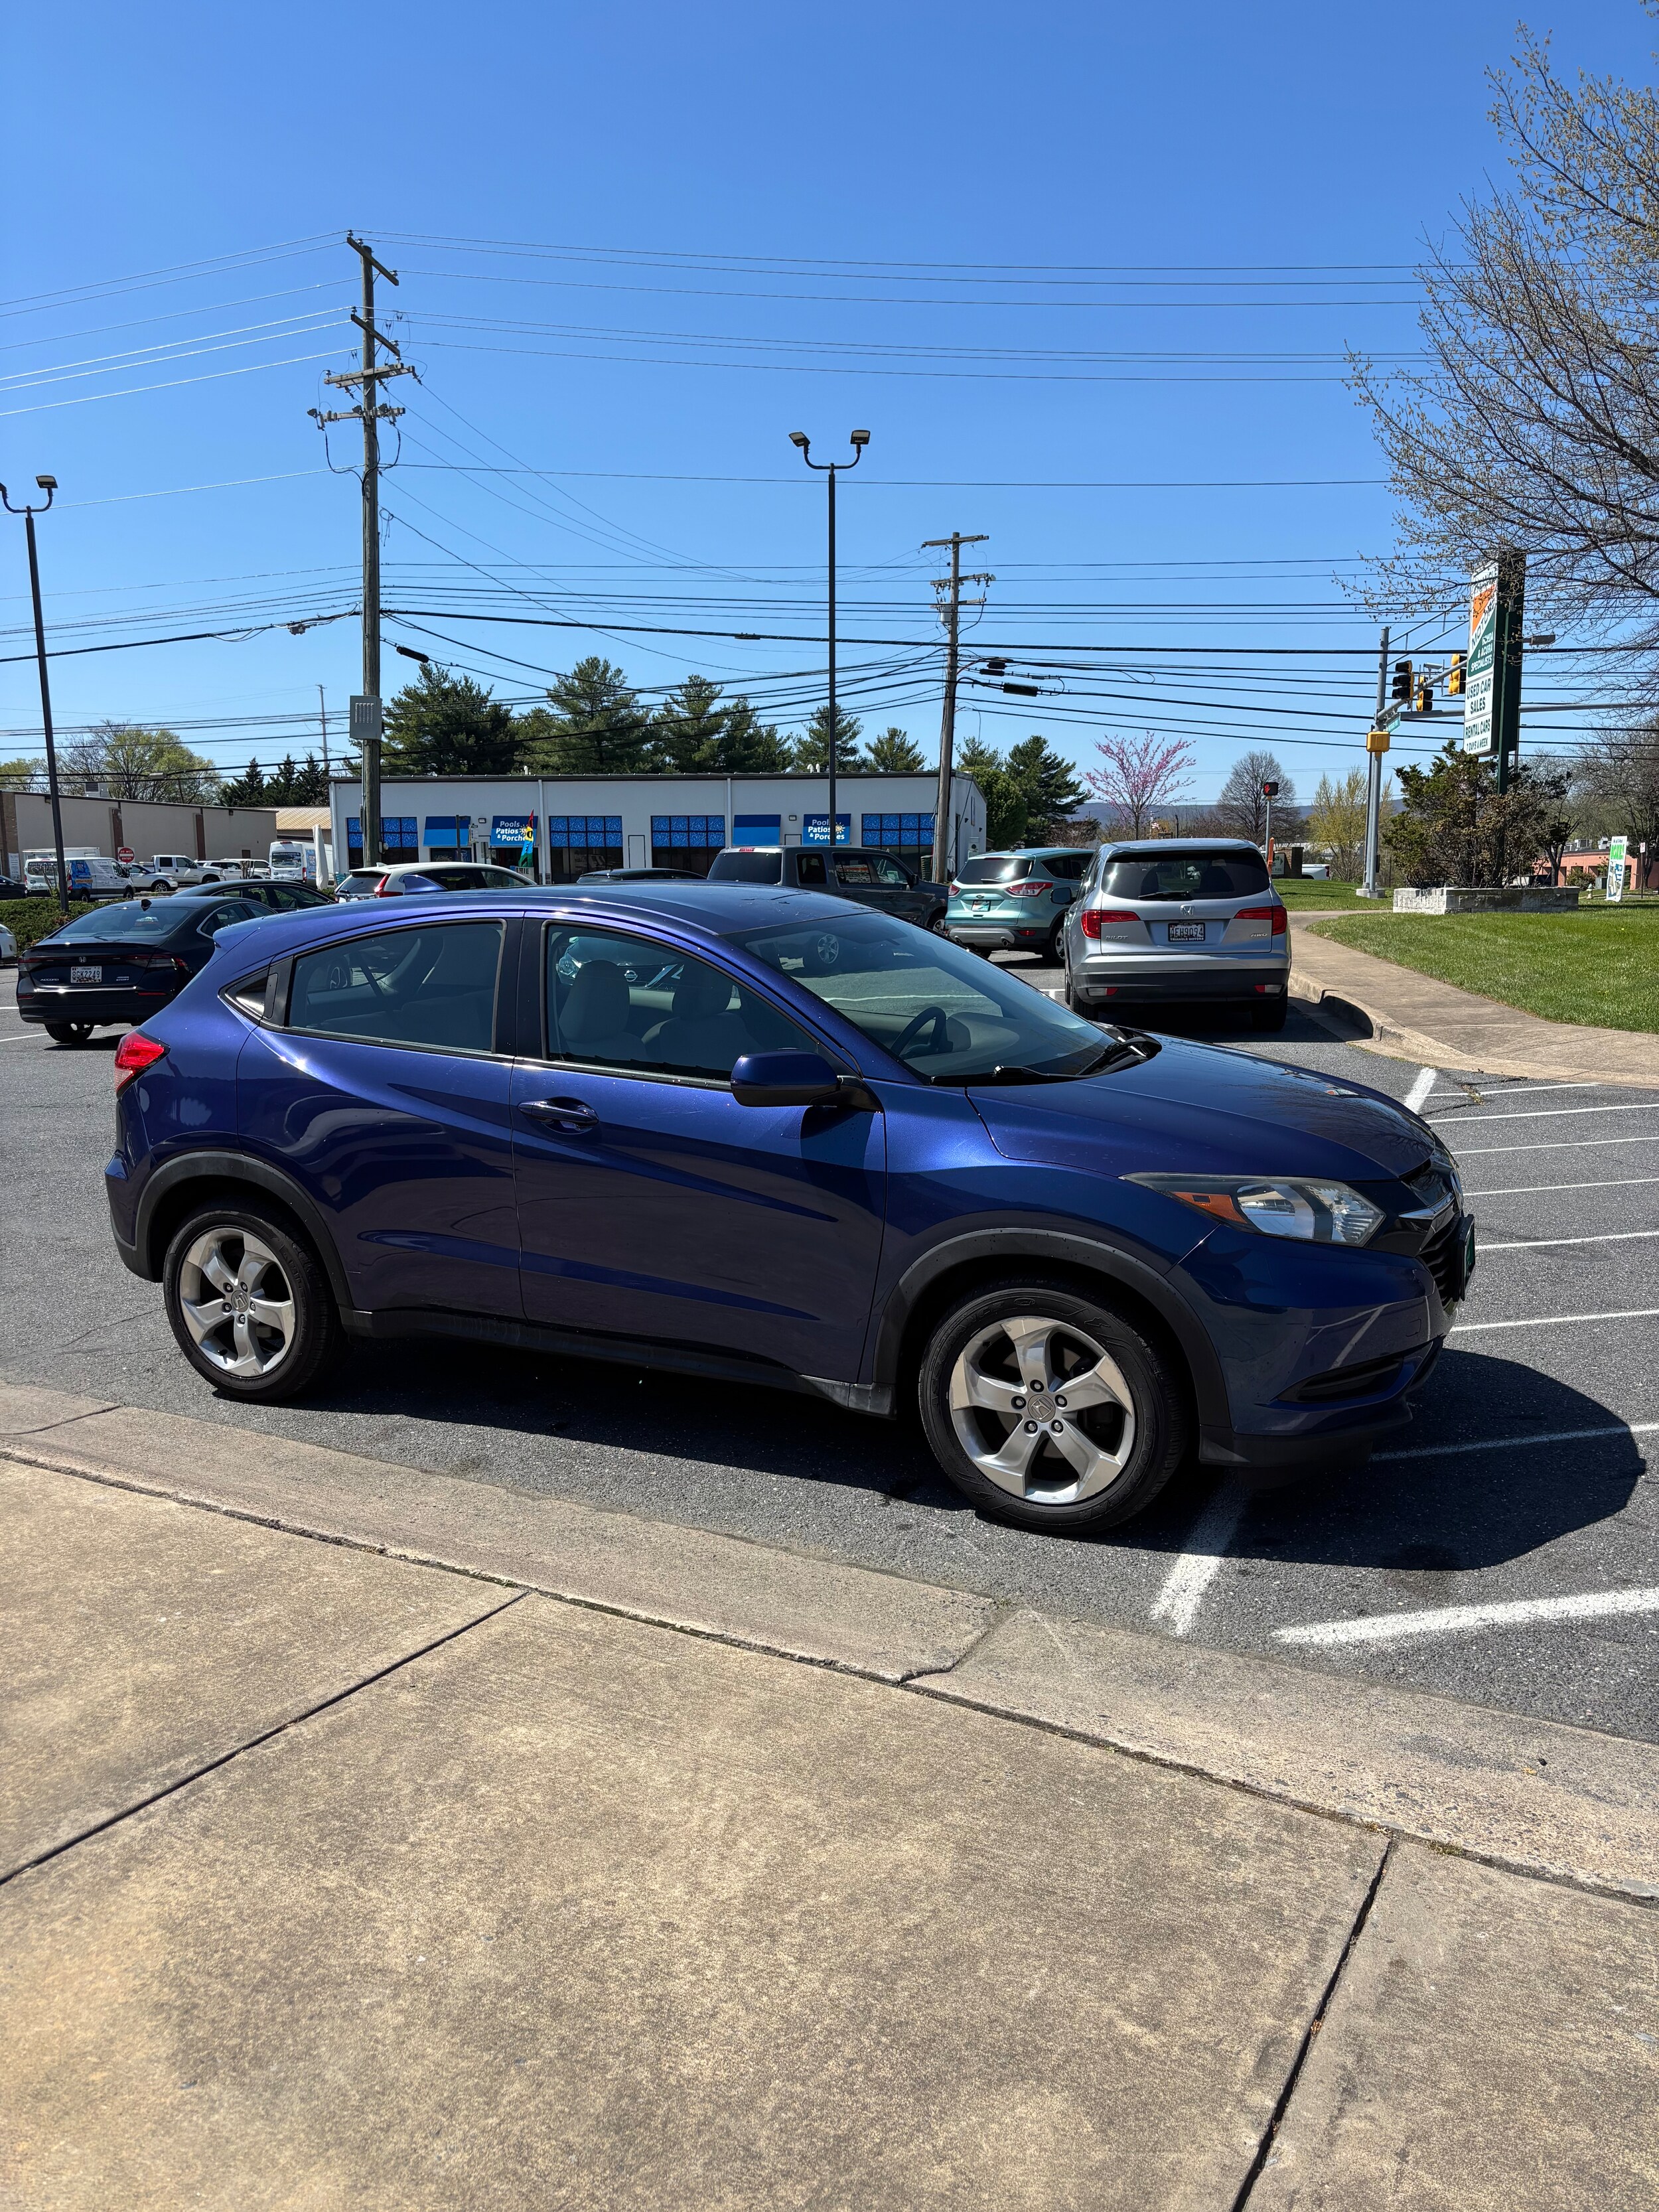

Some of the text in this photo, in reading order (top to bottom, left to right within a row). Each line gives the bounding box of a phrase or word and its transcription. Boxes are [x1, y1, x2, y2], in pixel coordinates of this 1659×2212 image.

[1480, 642, 1493, 657] ACURA
[1471, 654, 1492, 672] SPECIALISTS
[1467, 678, 1491, 700] USED CAR
[1470, 696, 1486, 715] SALES
[1465, 718, 1490, 739] RENTAL CARS
[1469, 740, 1477, 751] DAYS
[1479, 737, 1488, 748] WEEK
[72, 970, 100, 980] 8GK2249
